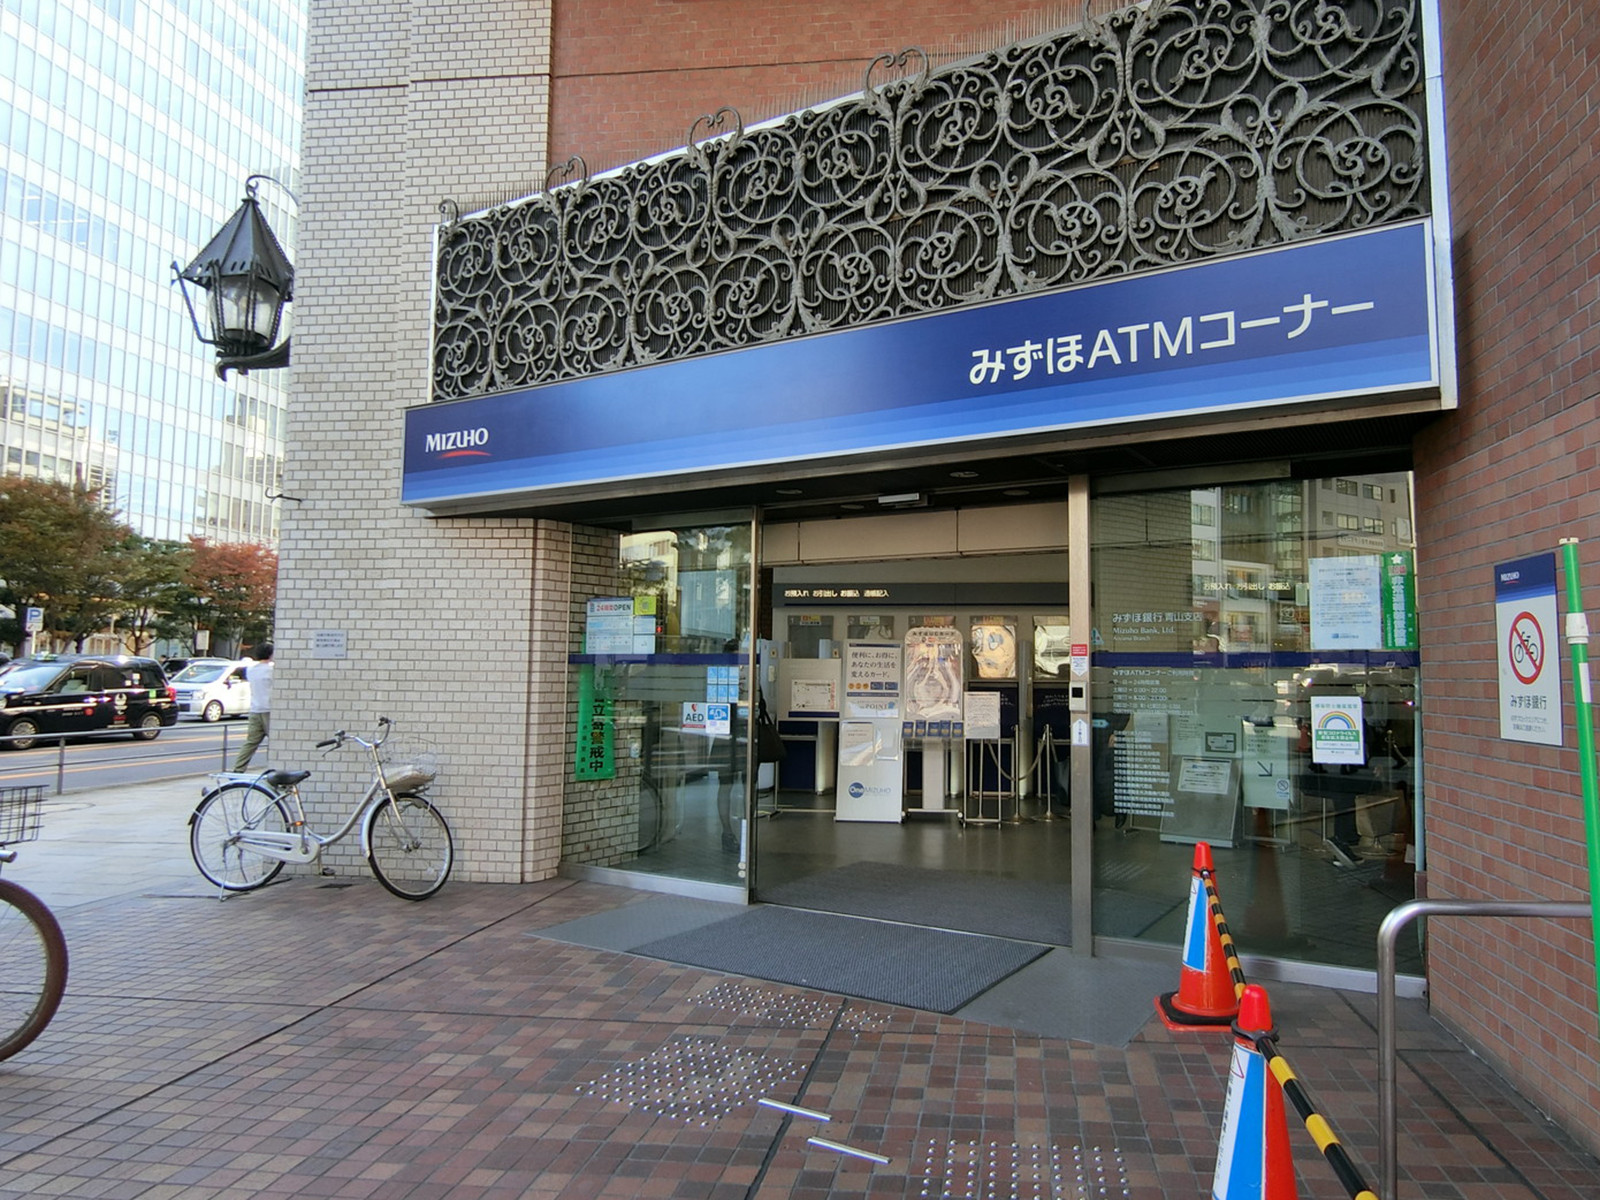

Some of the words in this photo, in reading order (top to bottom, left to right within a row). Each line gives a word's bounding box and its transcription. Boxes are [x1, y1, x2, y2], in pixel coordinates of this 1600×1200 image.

[968, 293, 1376, 386] みずほATMコーナー
[424, 427, 490, 453] MIZUHO
[1500, 571, 1520, 582] MIZUHO
[29, 609, 41, 620] P
[1112, 612, 1162, 623] みずほ銀行
[1165, 611, 1203, 622] 青山支店
[1140, 627, 1160, 635] Bank,
[1162, 626, 1176, 634] Ltd.
[851, 651, 899, 660] 便利に、お得に、
[851, 661, 896, 669] あなたの生活を
[1510, 694, 1548, 710] みずほ銀行
[685, 713, 704, 722] AED
